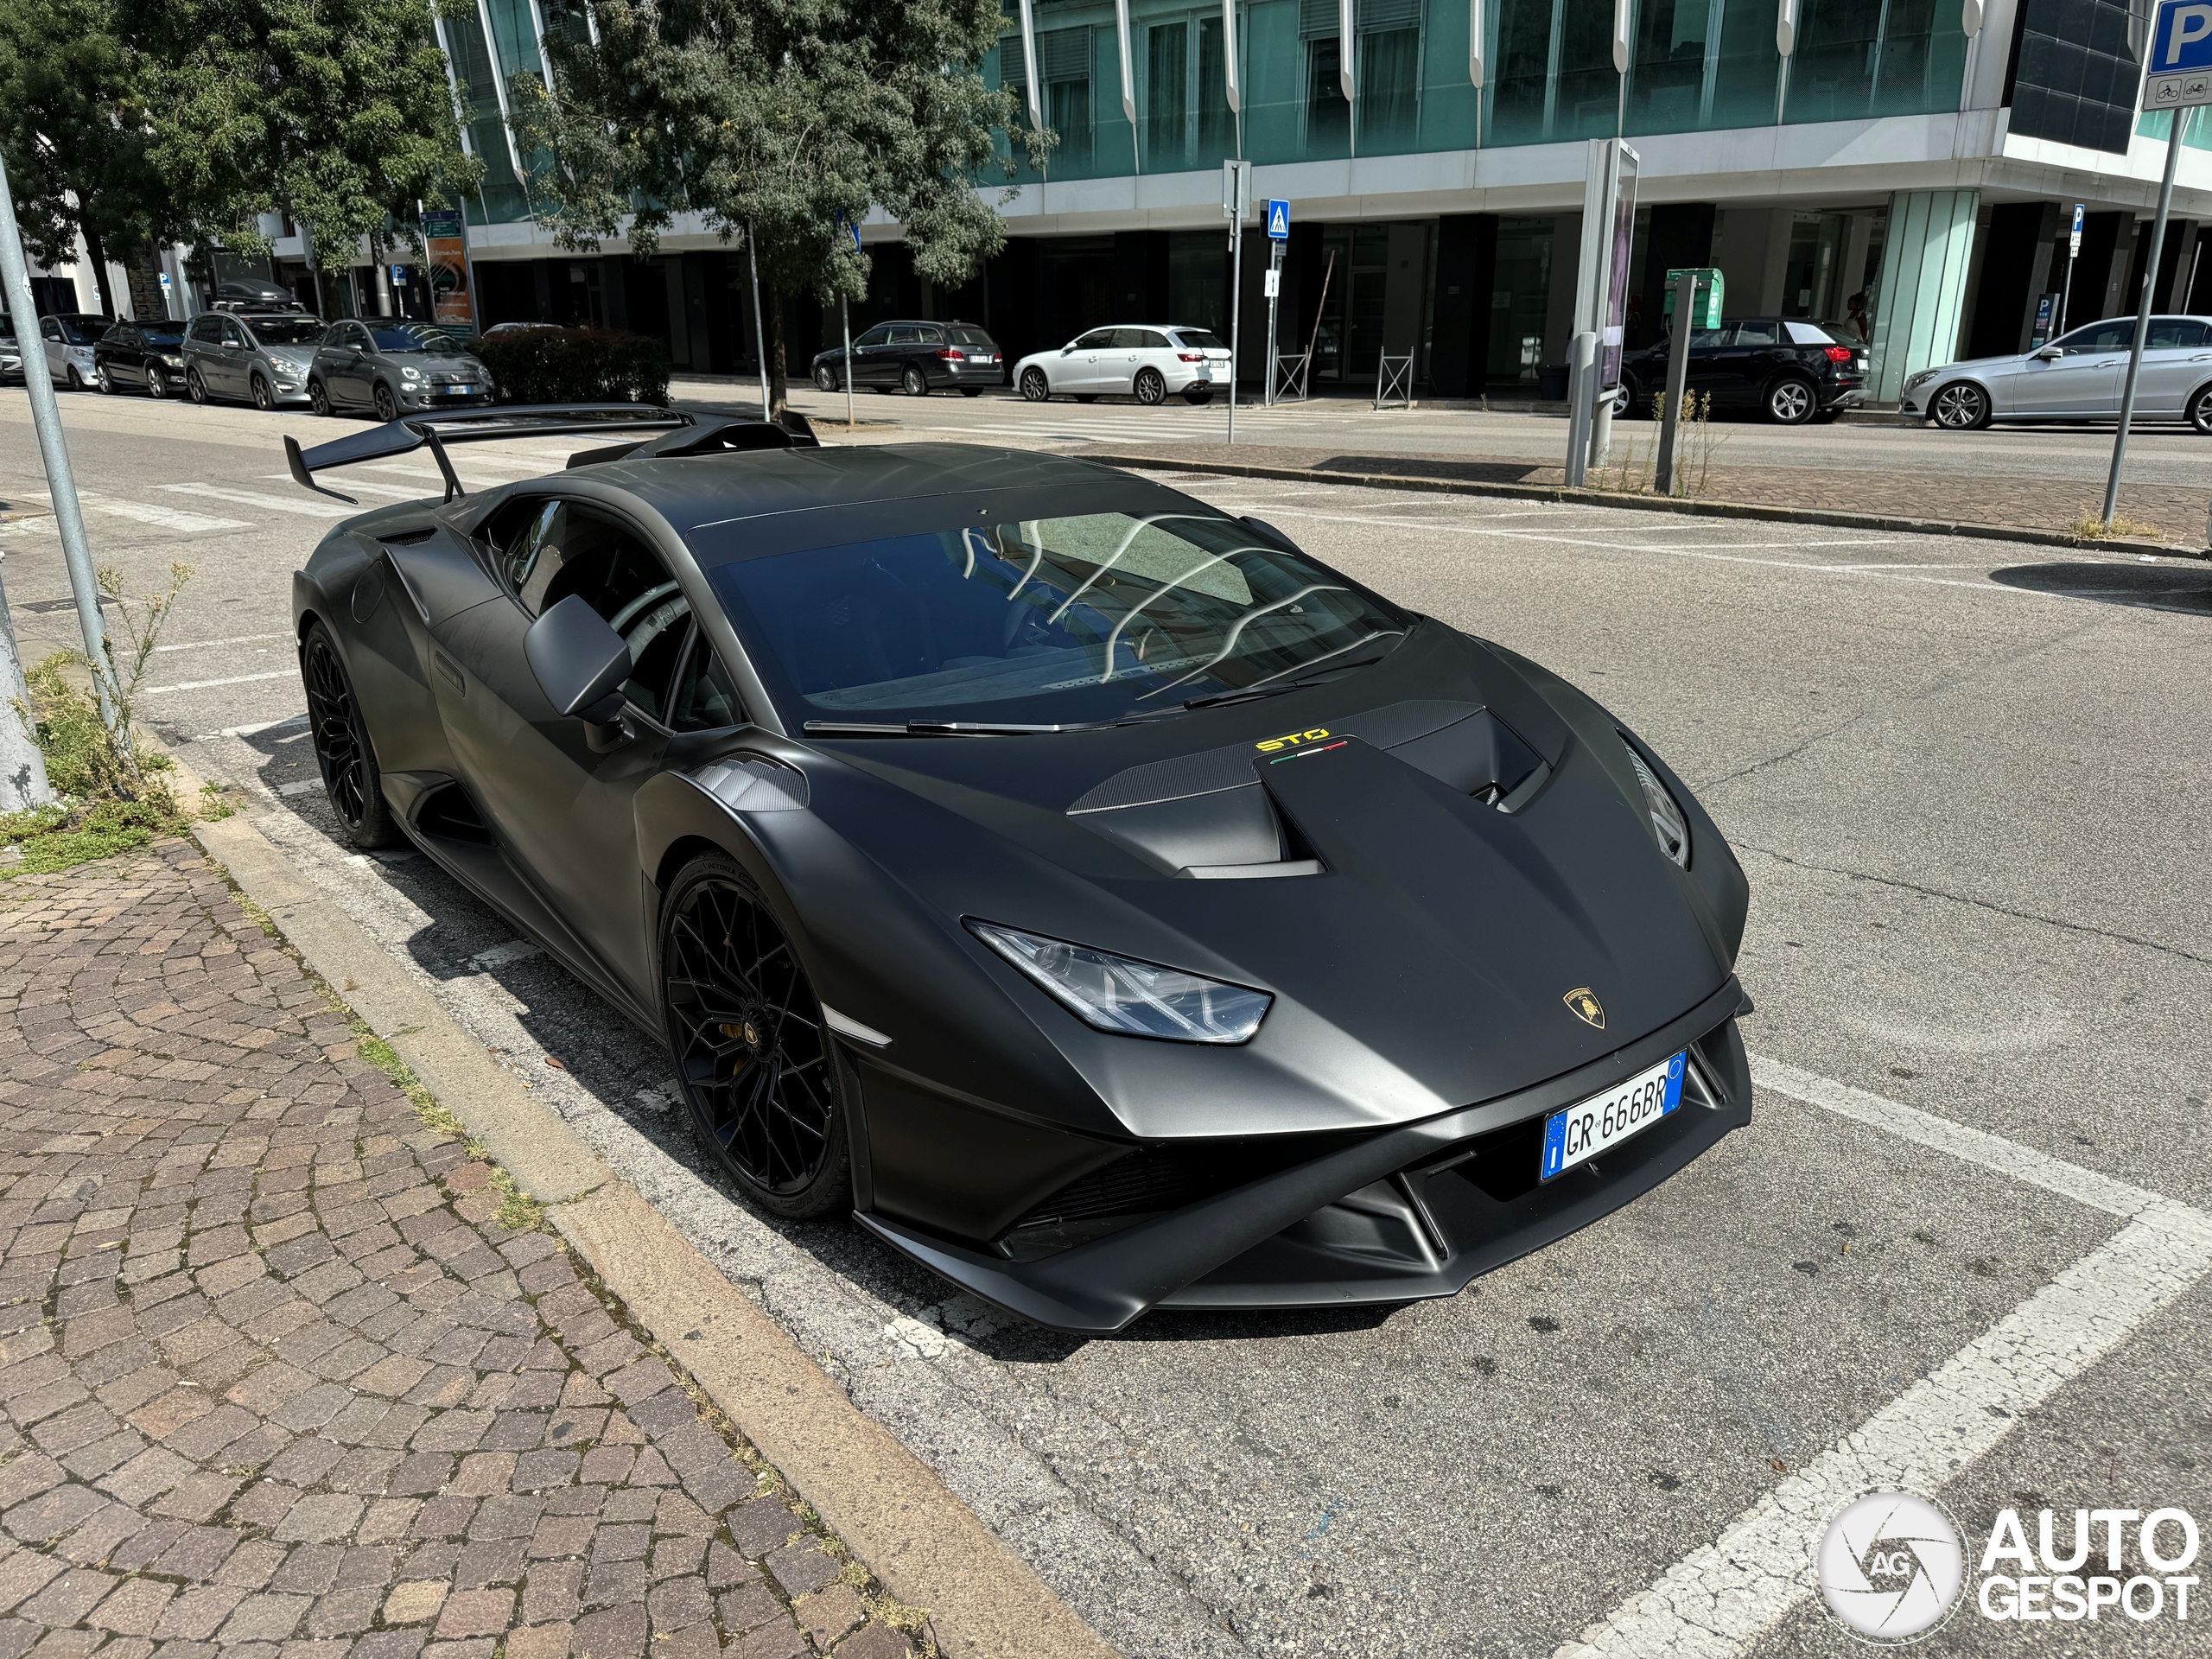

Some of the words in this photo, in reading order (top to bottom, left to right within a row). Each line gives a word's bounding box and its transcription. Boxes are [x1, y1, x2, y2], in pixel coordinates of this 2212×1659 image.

[2165, 3, 2212, 65] P
[2074, 207, 2082, 230] P
[160, 274, 168, 283] P
[2039, 299, 2050, 311] P
[1255, 728, 1330, 752] STO
[708, 862, 736, 875] POTENZA
[1566, 1112, 1594, 1157] GR
[1601, 1074, 1668, 1139] 666BR
